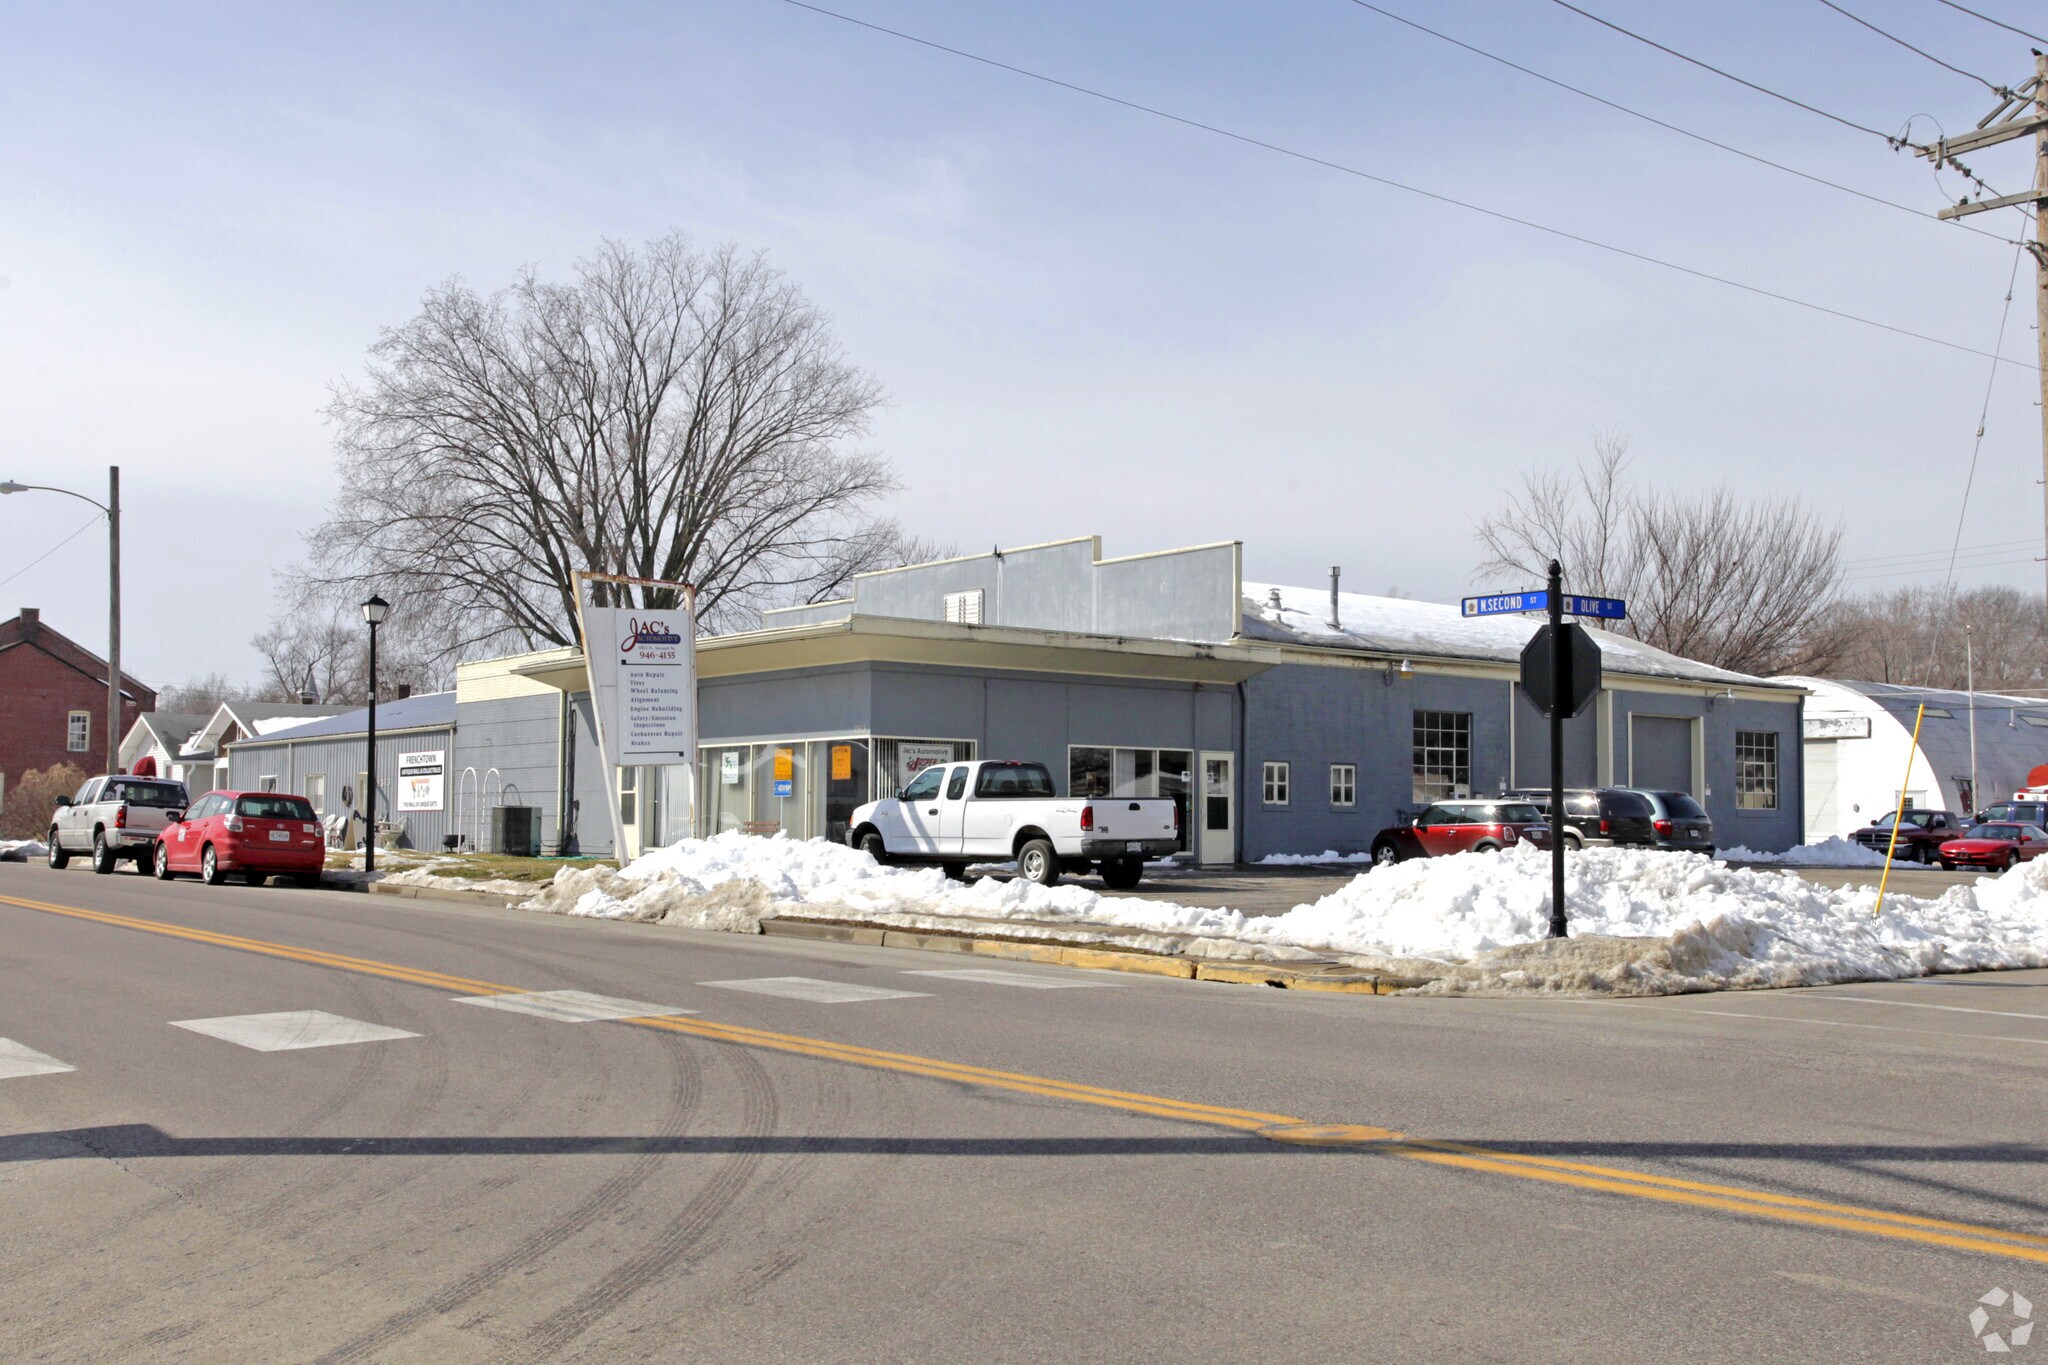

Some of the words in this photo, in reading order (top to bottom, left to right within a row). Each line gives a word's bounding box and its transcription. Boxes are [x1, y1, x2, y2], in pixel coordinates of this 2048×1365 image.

[1529, 596, 1537, 604] ST
[1580, 600, 1600, 613] OLIVE
[1606, 602, 1613, 610] ST
[621, 617, 670, 652] JAC's
[638, 635, 679, 643] AUTOMOTIVE
[639, 651, 676, 660] 946-4155
[406, 754, 437, 764] FRENCHTOWN
